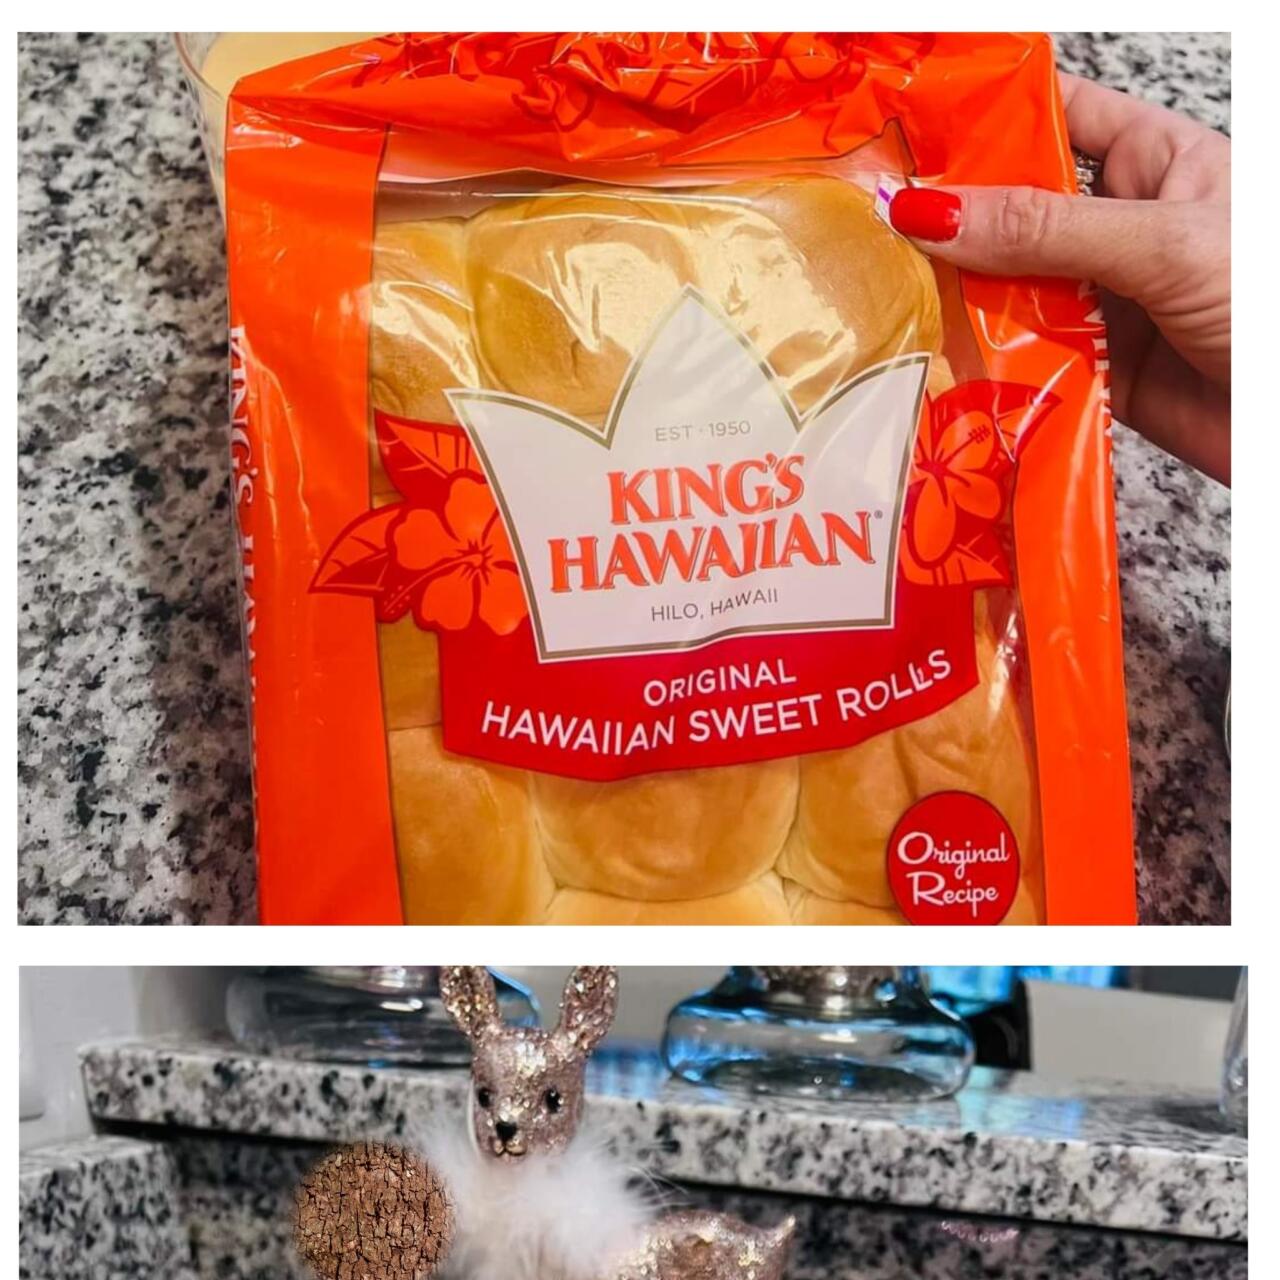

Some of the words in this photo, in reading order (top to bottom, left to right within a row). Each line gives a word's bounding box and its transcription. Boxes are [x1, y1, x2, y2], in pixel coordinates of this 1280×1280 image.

[655, 425, 693, 442] EST
[708, 420, 752, 438] 1950
[606, 452, 805, 526] KING'S
[547, 510, 876, 593] HAWAIIAN
[651, 602, 705, 622] HILO,
[710, 588, 779, 616] HAWAII
[481, 700, 675, 756] HAWAIIAN
[688, 694, 822, 743] SWEET
[835, 648, 952, 721] ROLLS
[643, 658, 797, 707] ORIGINAL
[897, 831, 1011, 880] Original
[905, 870, 999, 918] Recipe
